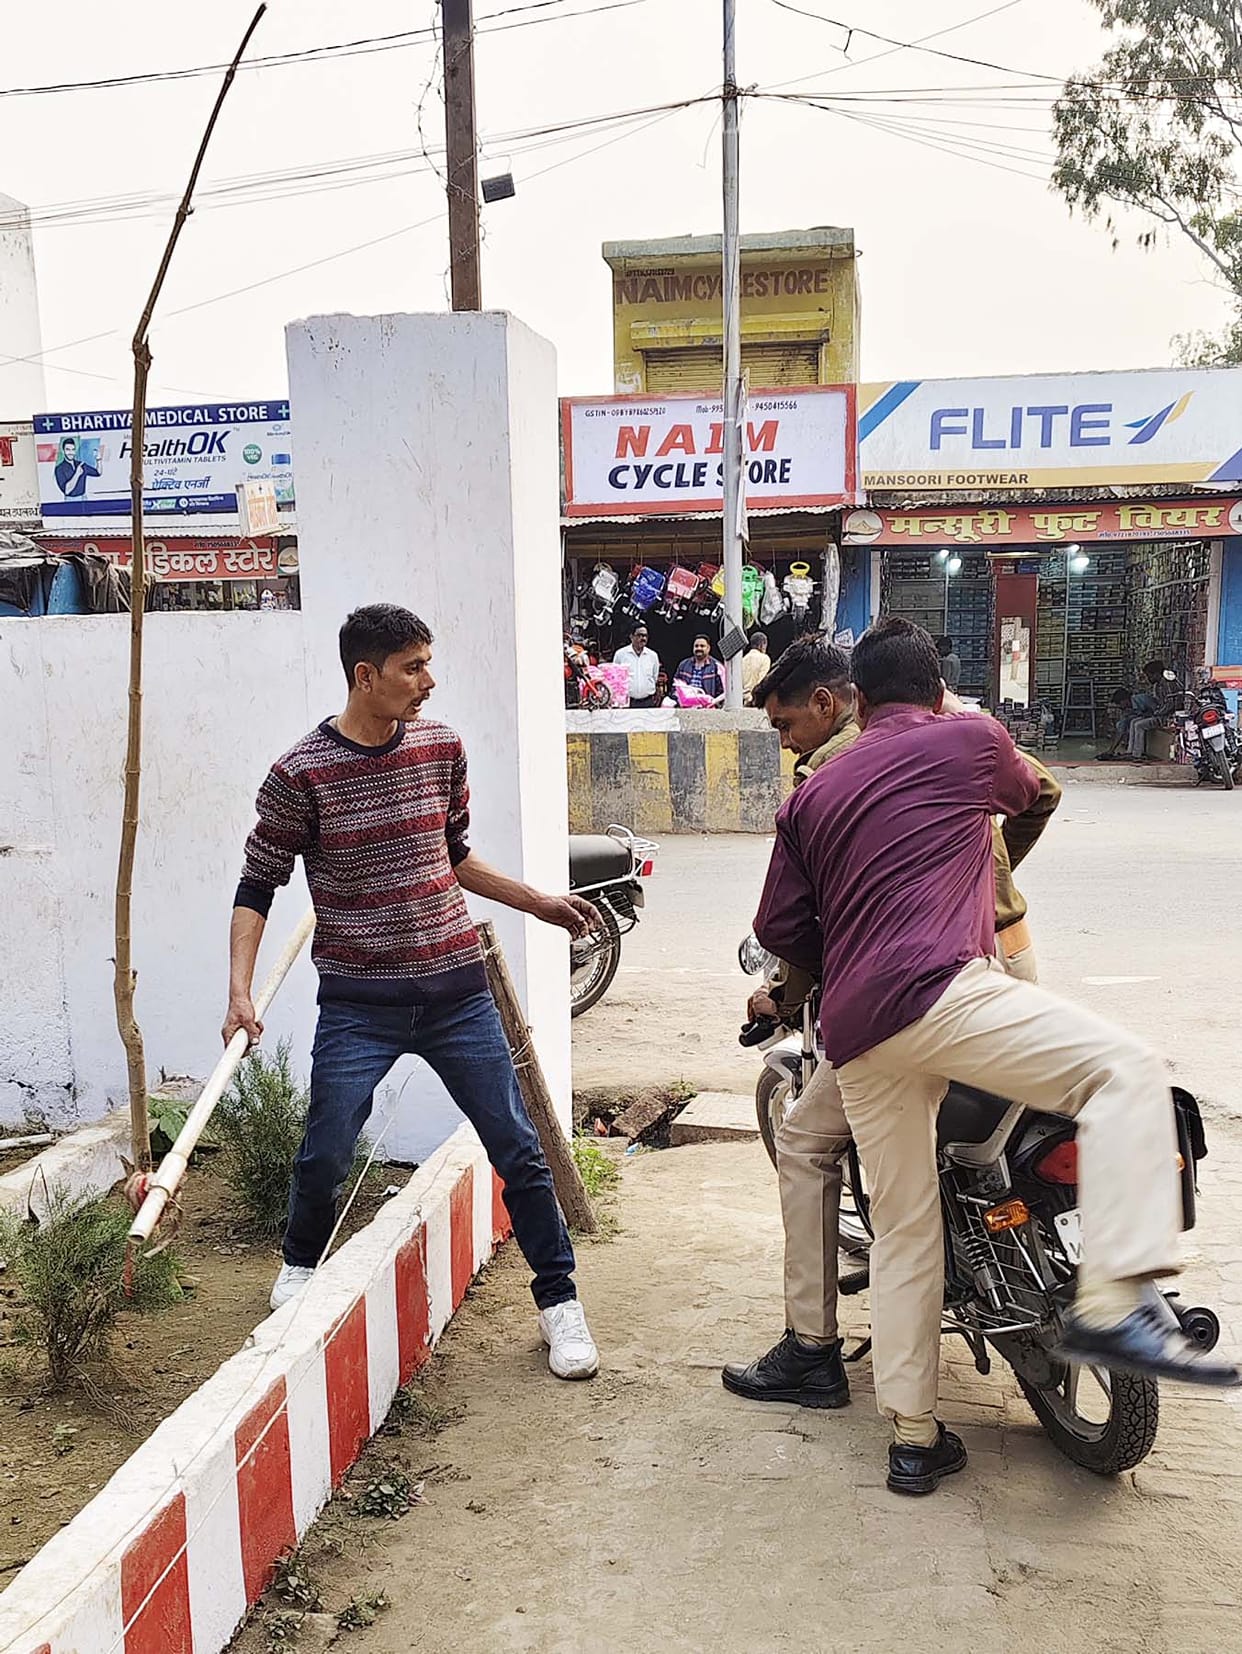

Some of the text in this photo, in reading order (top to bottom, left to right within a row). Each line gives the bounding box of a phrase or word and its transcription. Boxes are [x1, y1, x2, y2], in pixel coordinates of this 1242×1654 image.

[615, 274, 693, 304] NAIM
[754, 269, 829, 297] STORE
[144, 409, 213, 425] MEDICAL
[218, 405, 268, 421] STORE
[929, 403, 1113, 451] FLITE
[615, 420, 779, 459] NAIM
[143, 455, 226, 466] ULTIVITAMIN TABLETS
[608, 458, 791, 490] CYCLE SORE
[864, 473, 1029, 486] MANSOORI FOOTWEAR
[886, 504, 1225, 543] मन्सूरी फुट वियर
[222, 539, 274, 572] स्टोर
